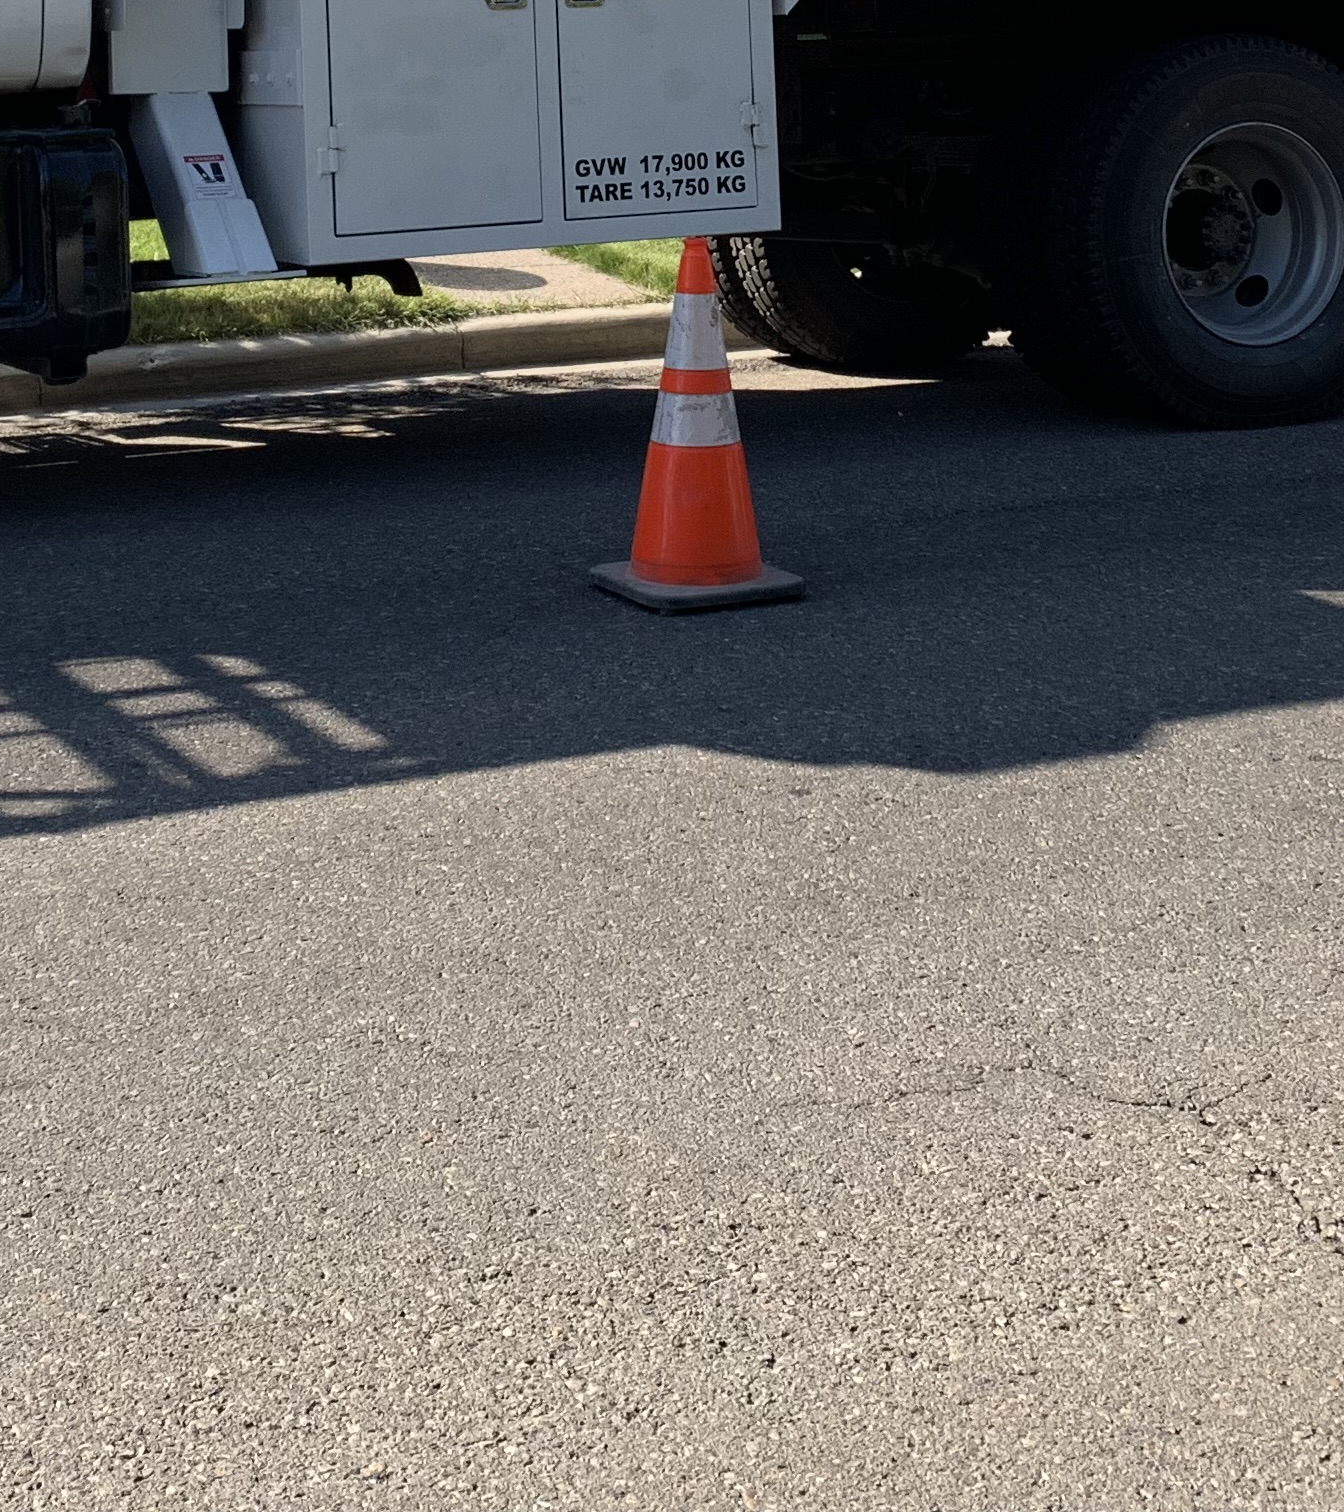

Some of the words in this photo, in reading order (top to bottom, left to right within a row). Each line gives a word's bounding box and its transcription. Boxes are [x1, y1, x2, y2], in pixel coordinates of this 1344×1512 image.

[575, 157, 627, 178] GVW
[639, 152, 709, 176] 17,900
[716, 150, 745, 169] KG
[575, 182, 633, 203] TARE
[640, 177, 709, 202] 13,750
[716, 175, 746, 194] KG
